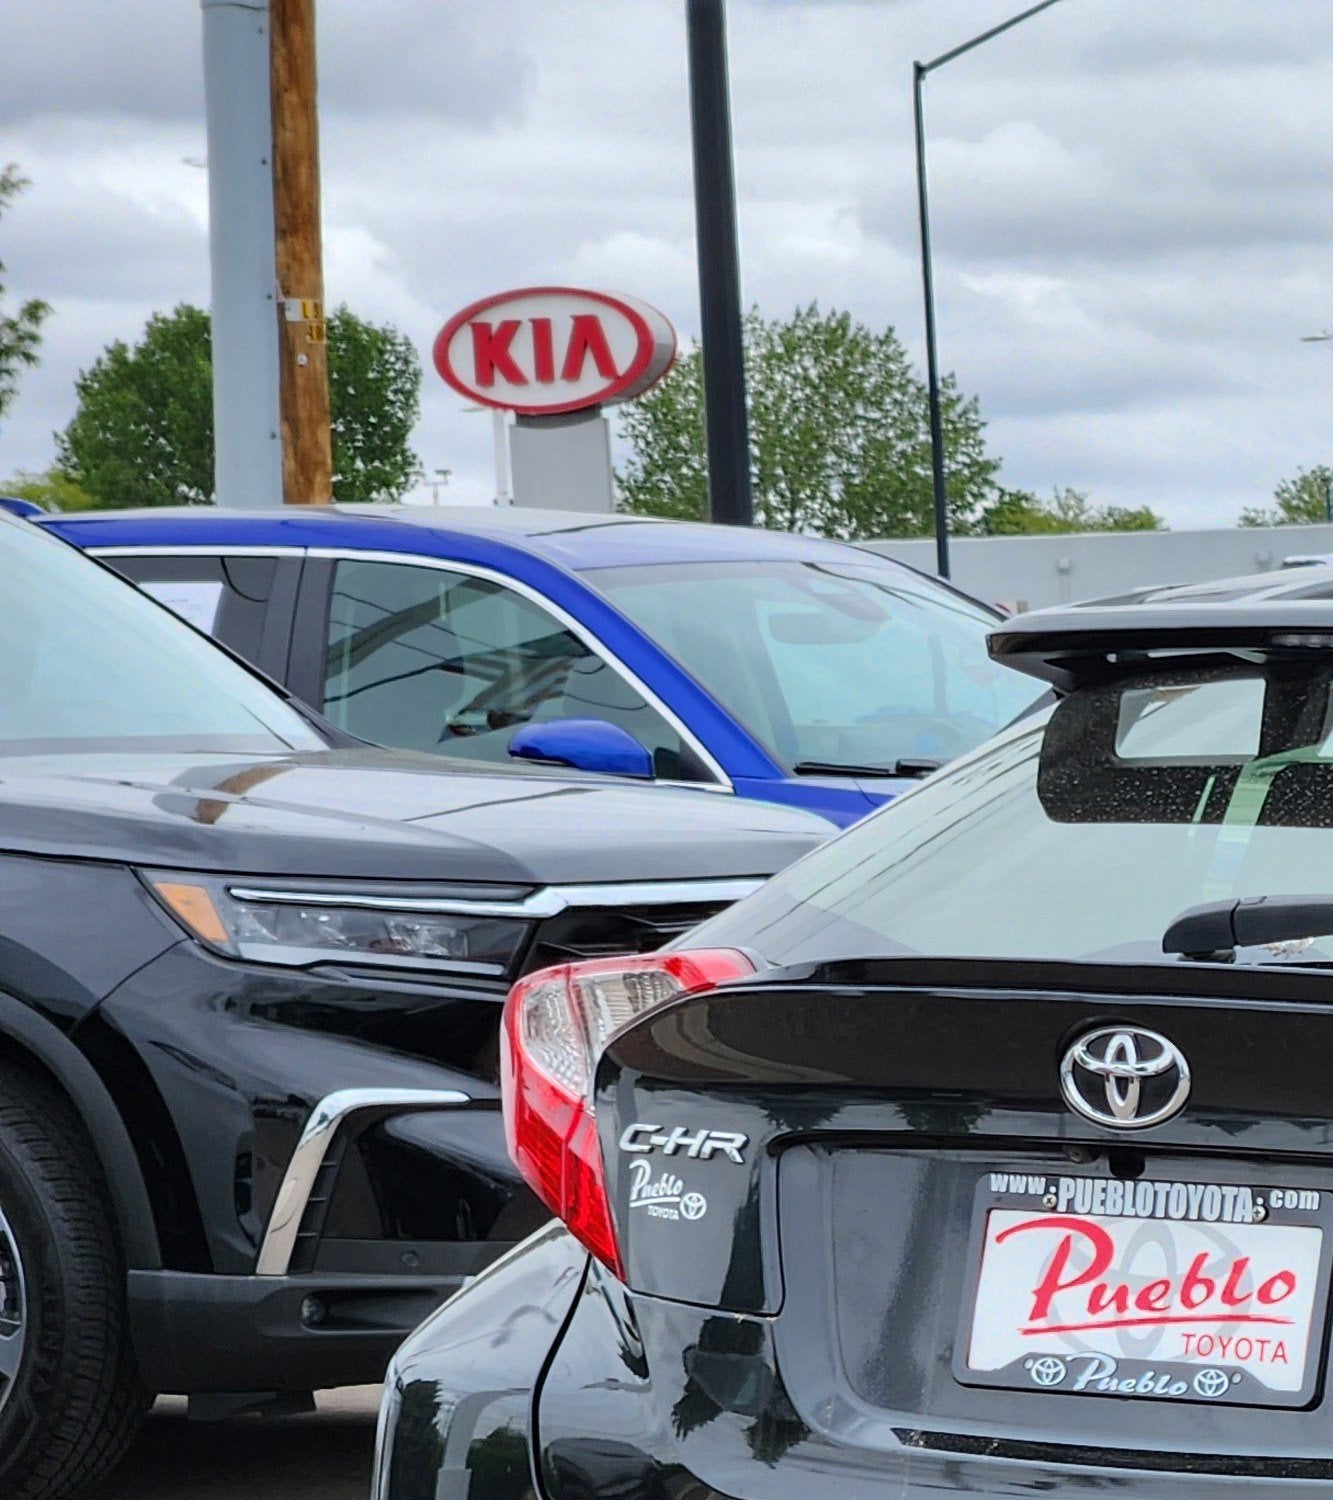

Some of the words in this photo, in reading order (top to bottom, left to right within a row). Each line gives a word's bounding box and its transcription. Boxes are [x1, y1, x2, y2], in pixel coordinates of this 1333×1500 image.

[468, 314, 620, 387] KIA
[619, 1123, 749, 1164] C-HR
[629, 1159, 684, 1200] Pueblo
[996, 1217, 1297, 1321] Pueblo
[1181, 1334, 1288, 1364] TOYOTA
[1067, 1351, 1188, 1397] Pueblo
